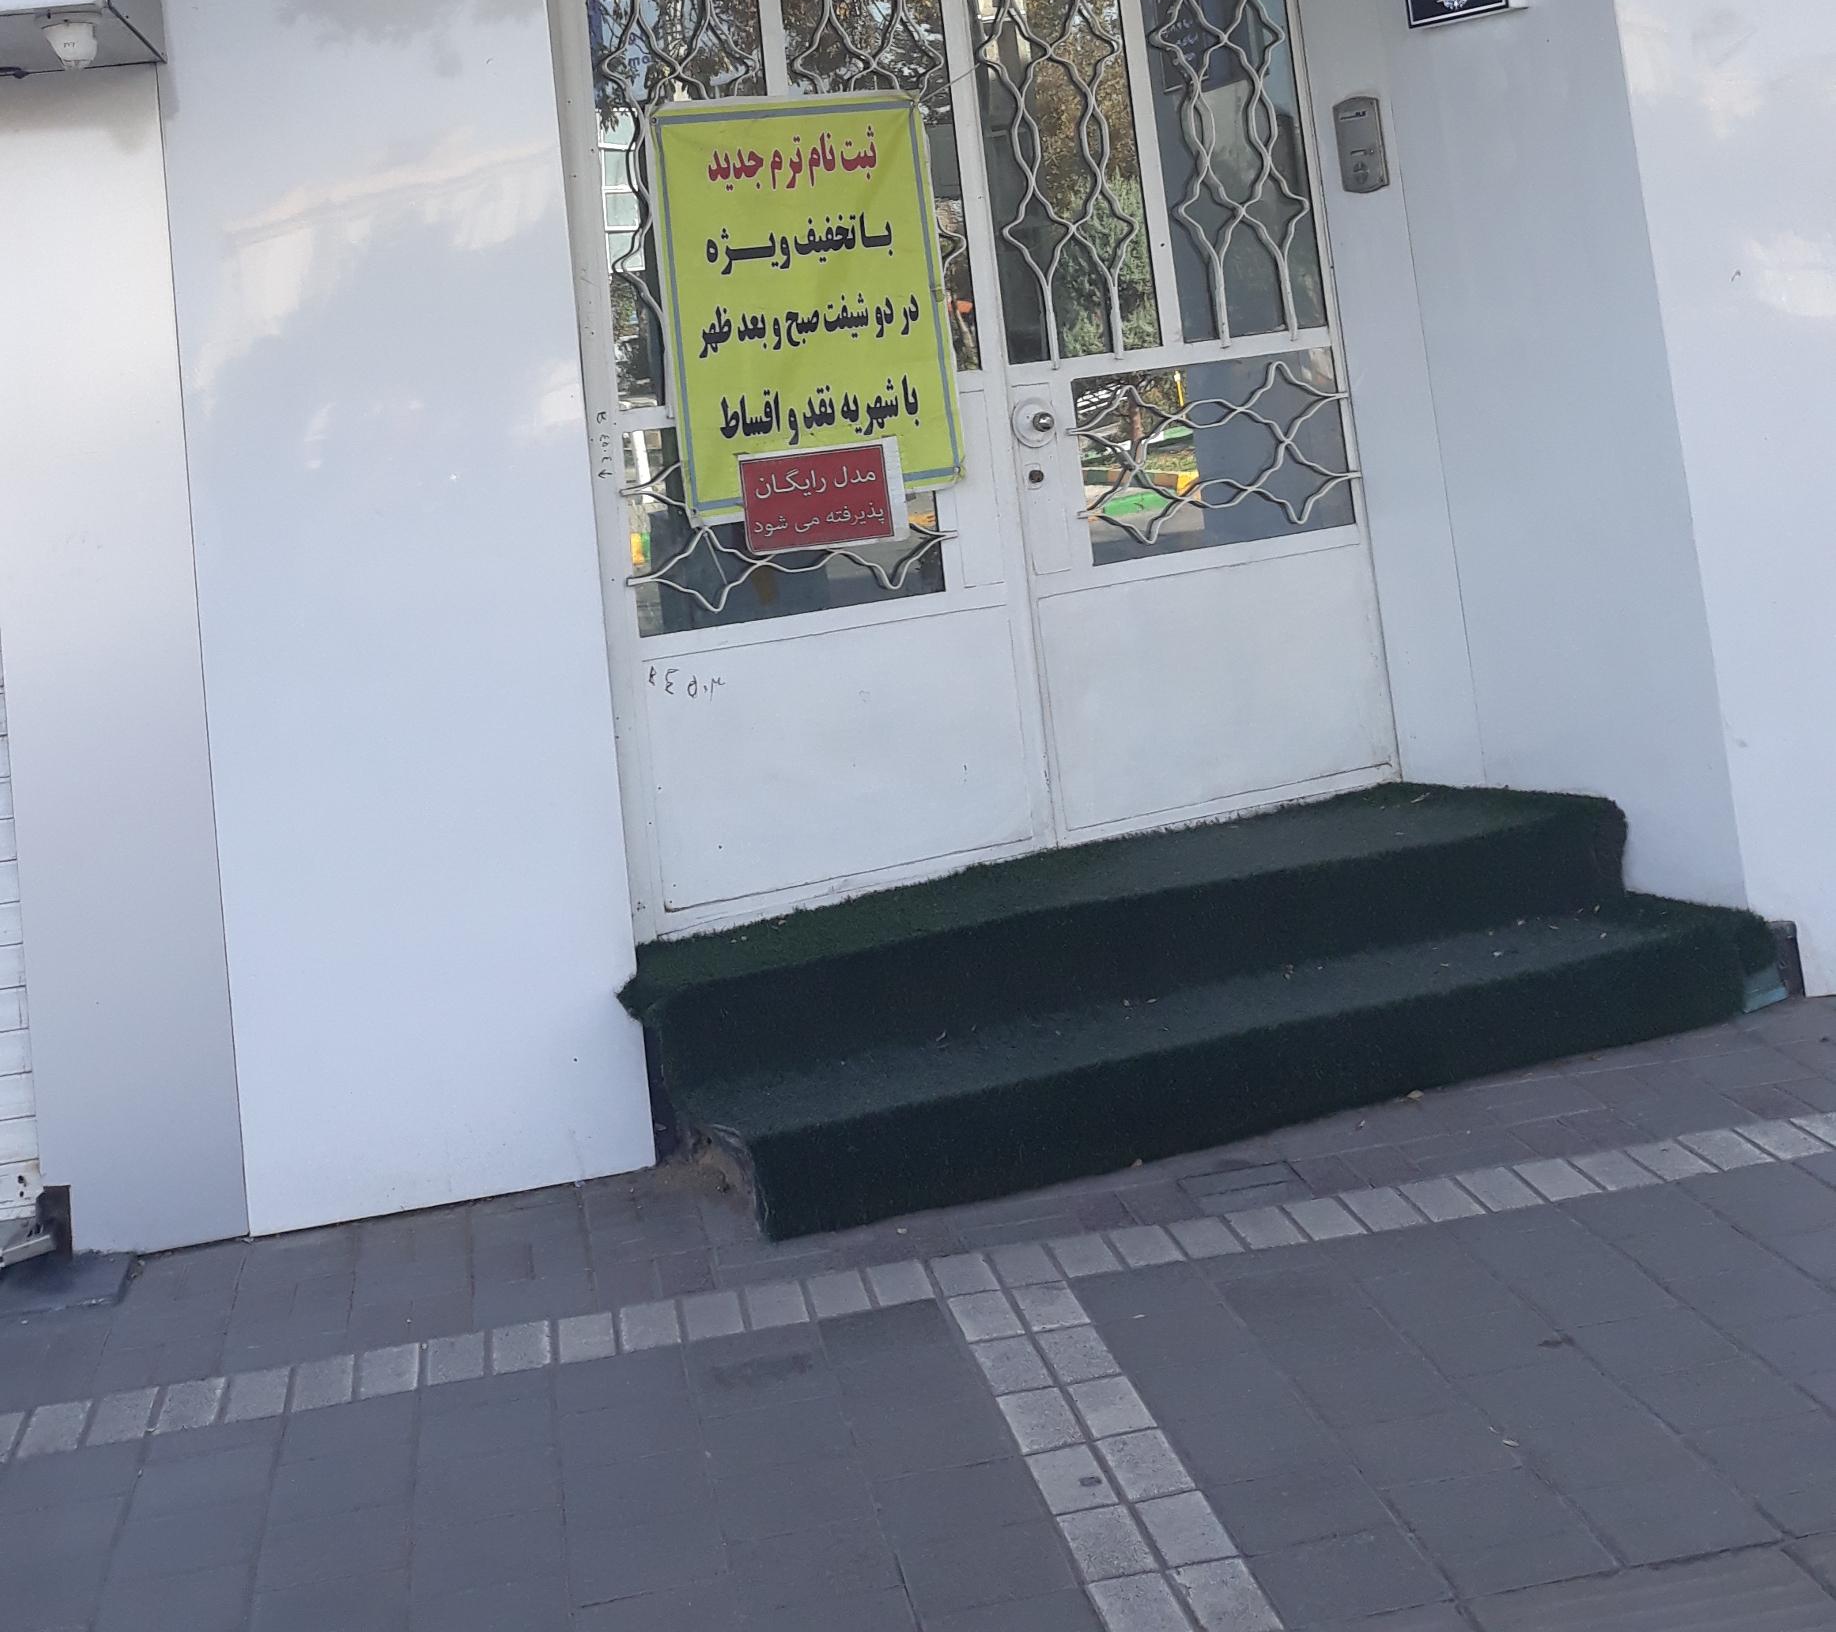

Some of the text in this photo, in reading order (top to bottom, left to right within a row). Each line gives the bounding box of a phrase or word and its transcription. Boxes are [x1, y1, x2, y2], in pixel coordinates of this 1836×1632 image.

[708, 125, 877, 191] ثبت نام ترم جدید
[706, 211, 894, 275] با تخفیف ویژه
[698, 292, 920, 359] در دو شیفت صبح و بعد ظهر
[719, 374, 920, 446] با شهریه نقد و اقساط
[755, 465, 877, 499] مدل رایگان
[754, 502, 885, 537] پذیرفته می شود
